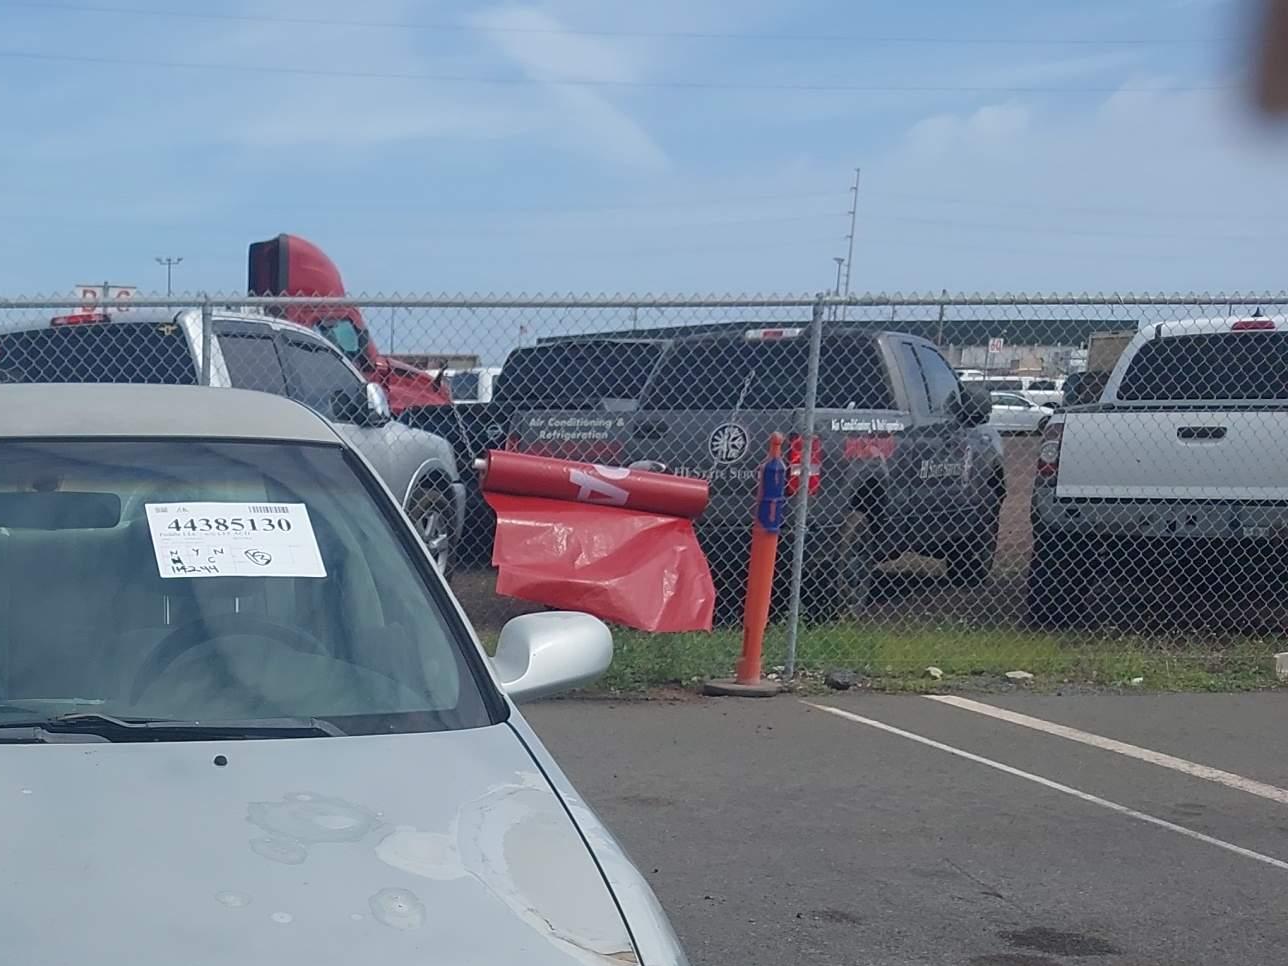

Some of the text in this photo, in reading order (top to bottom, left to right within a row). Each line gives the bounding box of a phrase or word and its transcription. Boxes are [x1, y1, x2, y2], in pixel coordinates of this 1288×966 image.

[529, 418, 544, 426] Air
[548, 417, 612, 429] Conditioning
[539, 430, 608, 440] Refrigeration
[168, 518, 291, 532] 44385130
